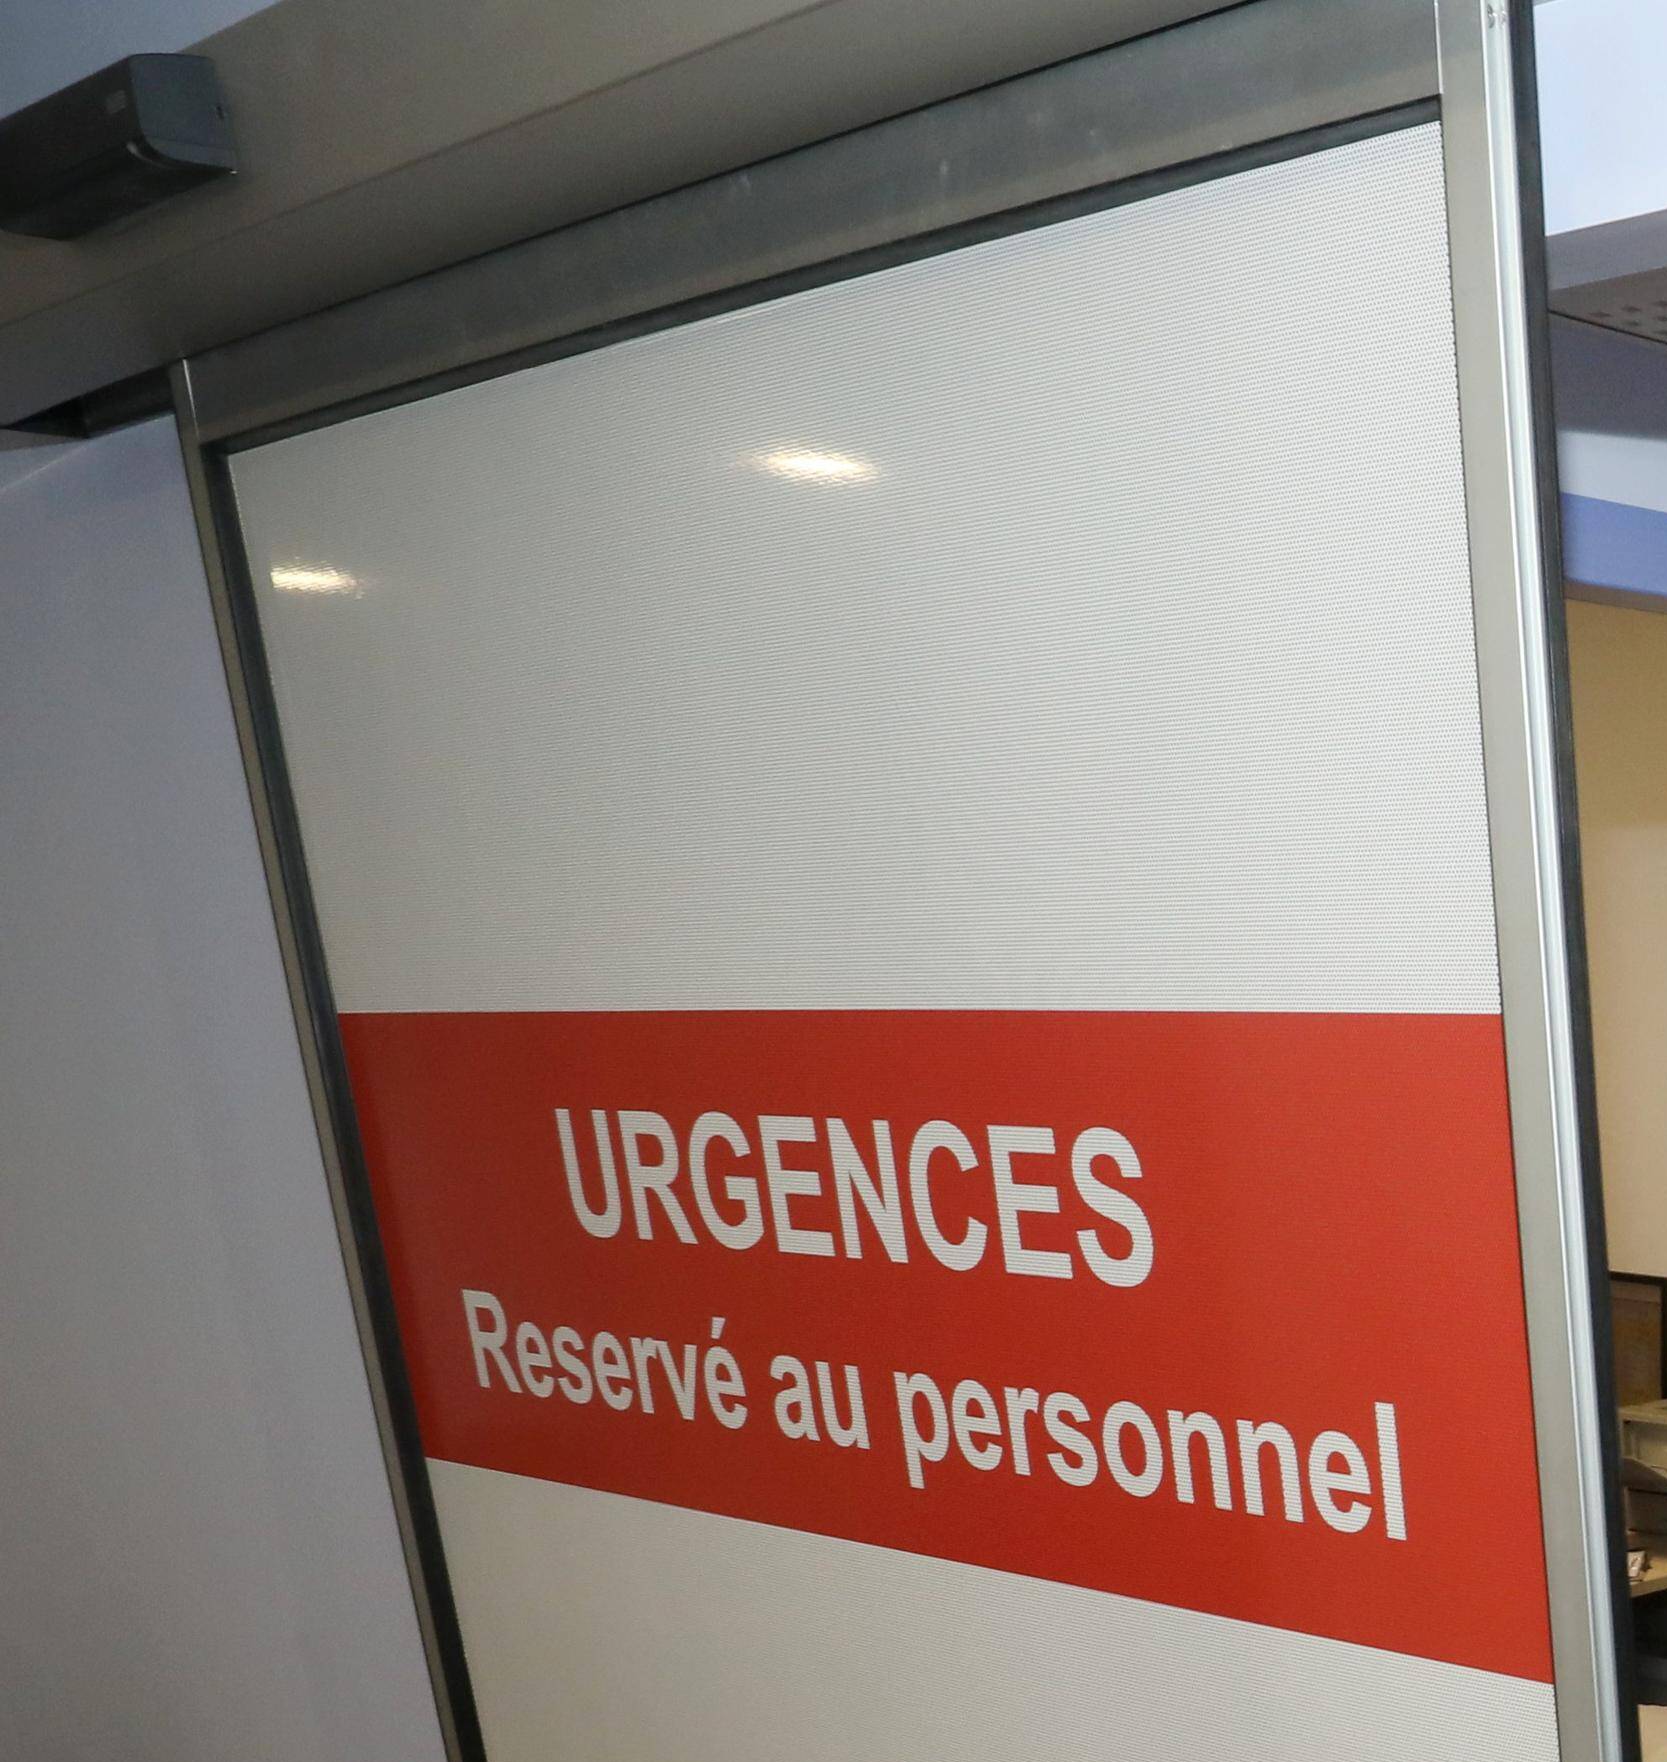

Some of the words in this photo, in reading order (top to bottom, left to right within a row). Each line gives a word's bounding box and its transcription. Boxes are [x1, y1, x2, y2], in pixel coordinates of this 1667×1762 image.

[554, 1108, 1155, 1288] URGENCES
[461, 1289, 748, 1430] Reservé
[769, 1355, 871, 1450] au
[892, 1371, 1409, 1541] personnel
